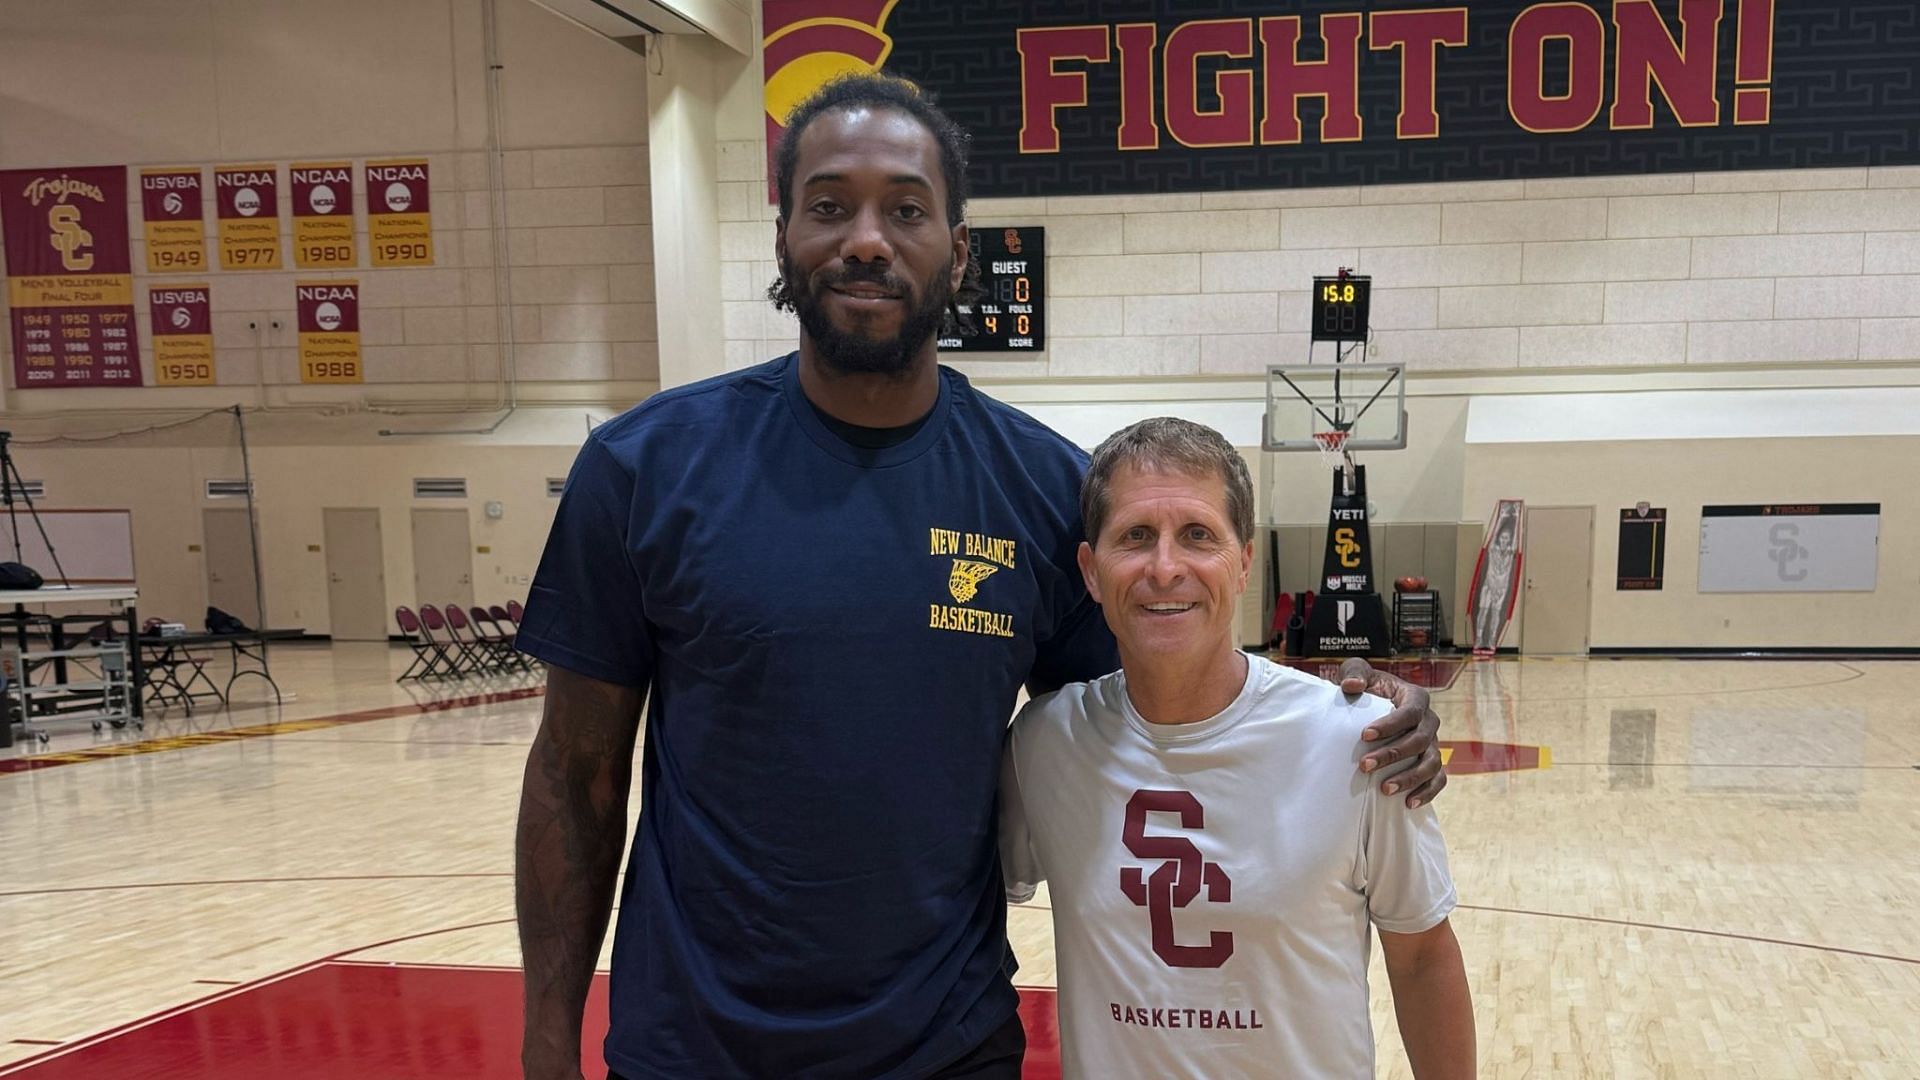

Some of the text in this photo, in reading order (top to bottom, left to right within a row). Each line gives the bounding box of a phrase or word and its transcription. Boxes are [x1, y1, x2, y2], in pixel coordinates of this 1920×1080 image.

[1016, 0, 1774, 153] FIGHT ON!
[217, 172, 274, 187] NCAA
[292, 169, 350, 184] NCAA
[367, 166, 426, 182] NCAA
[23, 174, 105, 206] Trojans
[143, 176, 199, 190] USVBA
[49, 205, 94, 271] SC
[153, 250, 201, 266] 1949
[226, 248, 275, 264] 1977
[302, 246, 351, 262] 1980
[377, 244, 427, 260] 1990
[992, 262, 1027, 274] GUEST
[21, 278, 122, 289] MEN'S VOLLEYBALL
[1015, 277, 1030, 302] 0
[41, 291, 103, 301] FINAL FOUR
[152, 291, 207, 304] USVBA
[299, 287, 356, 301] NCAA
[1323, 284, 1355, 302] 15.8
[981, 305, 1002, 314] T.O.L.
[1009, 305, 1033, 314] FOULS
[23, 313, 128, 325] 1949 1950 1977
[985, 317, 997, 333] 4
[1017, 315, 1030, 335] 0
[62, 328, 91, 338] 1980
[103, 342, 128, 351] 1987
[1008, 338, 1033, 347] SCORE
[64, 355, 94, 365] 1990
[104, 356, 128, 365] 1991
[28, 369, 131, 380] 2009 2011 2012
[162, 364, 209, 380] 1950
[306, 362, 356, 377] 1988
[1333, 509, 1365, 520] YETI
[930, 527, 1016, 569] NEW BALANCE
[1334, 528, 1361, 568] SC
[1768, 523, 1809, 582] SC
[1342, 575, 1367, 583] MUSCLE
[929, 604, 1015, 638] BASKETBALL
[1320, 637, 1370, 645] PECHANGA
[1120, 789, 1234, 968] SC
[1110, 1003, 1263, 1029] BASKETBALL
